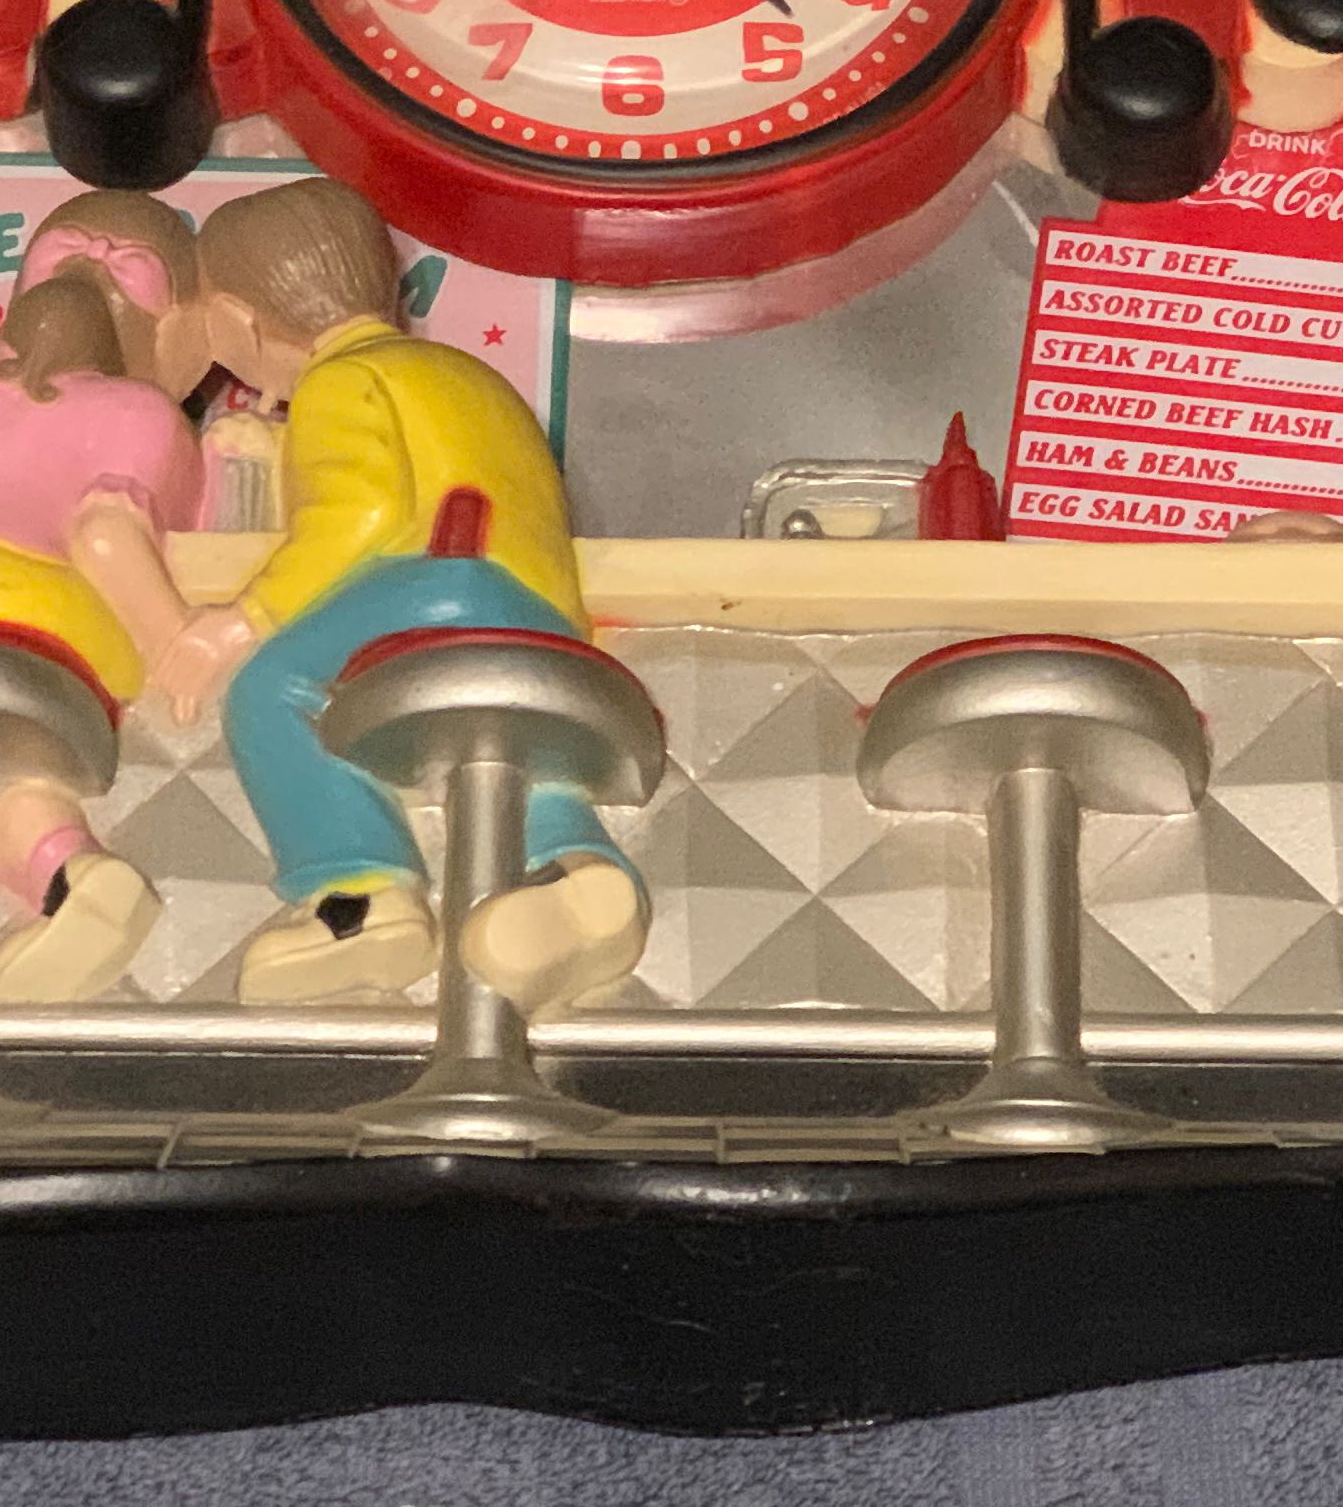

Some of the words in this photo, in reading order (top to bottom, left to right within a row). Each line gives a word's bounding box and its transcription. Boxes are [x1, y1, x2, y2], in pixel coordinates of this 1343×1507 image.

[467, 22, 534, 81] 7
[742, 20, 804, 83] 5
[601, 54, 666, 117] 6
[1248, 129, 1328, 155] DRINK
[1053, 239, 1156, 270] ROAST
[1161, 251, 1239, 279] BEEF
[1045, 288, 1203, 325] ASSORTED
[1213, 307, 1291, 335] COLD
[1038, 338, 1141, 369] STEAK
[1146, 349, 1243, 381] PLATE
[1033, 388, 1156, 421] CORNED
[1165, 402, 1245, 431] BEEF
[1248, 411, 1334, 441] HASH
[1025, 440, 1096, 467] HAM
[1104, 449, 1129, 472] &
[1138, 453, 1239, 484] BEANS
[1016, 491, 1081, 518] EGG
[1088, 497, 1186, 529] SALAD
